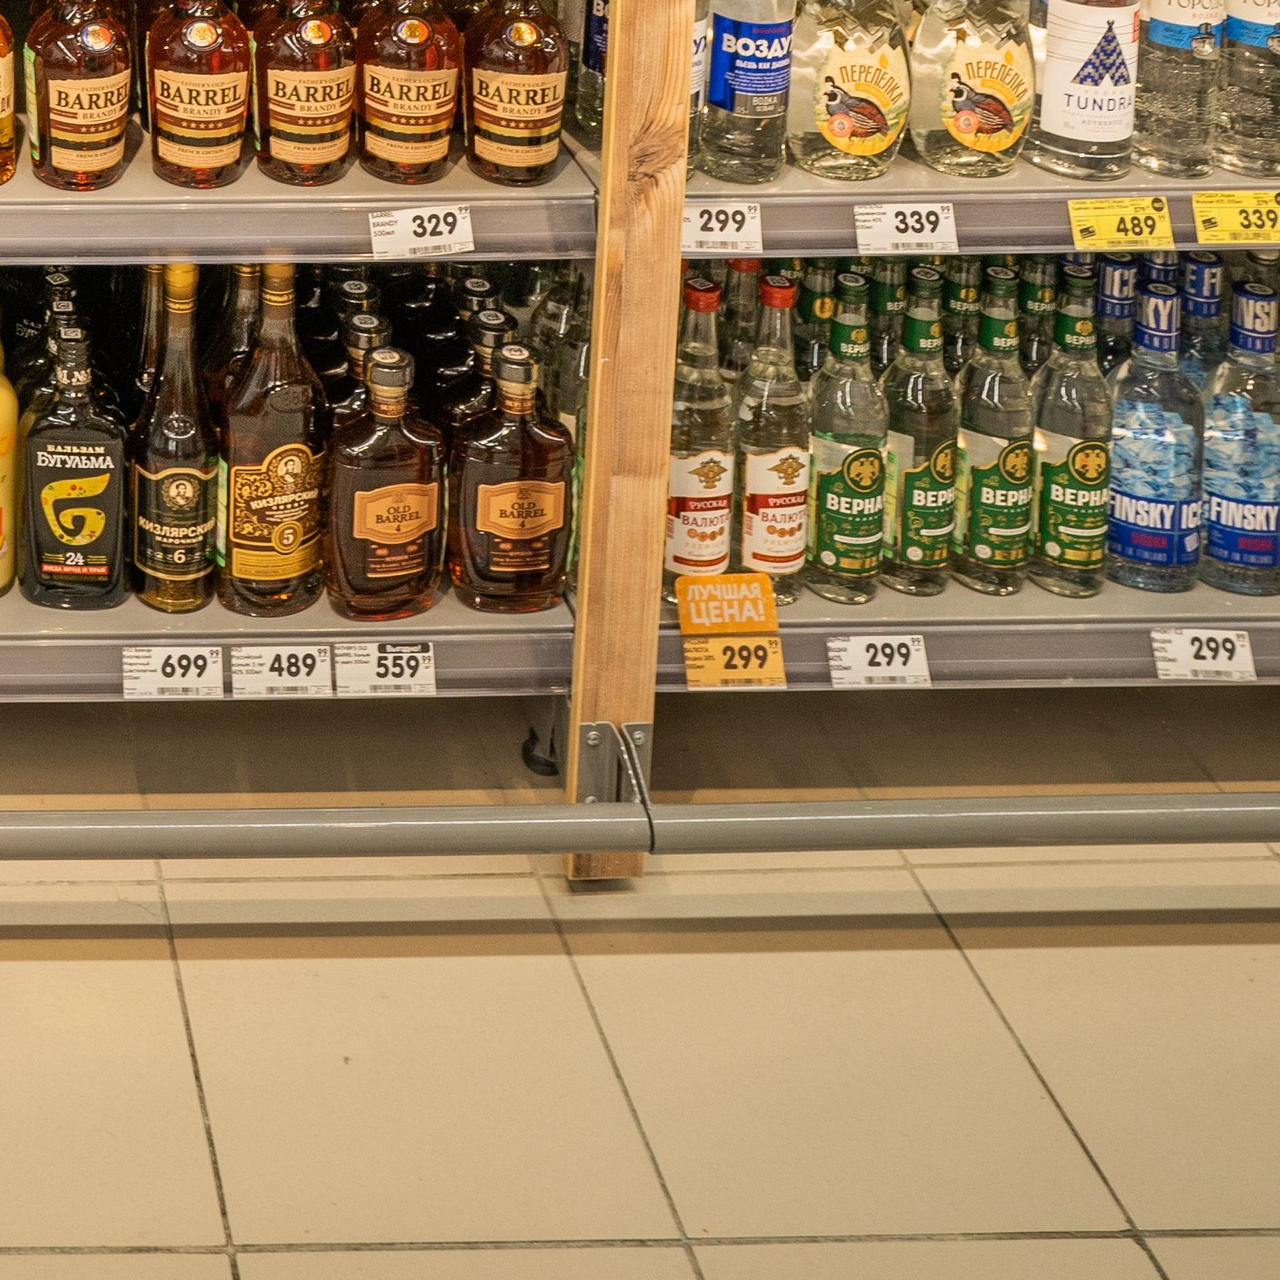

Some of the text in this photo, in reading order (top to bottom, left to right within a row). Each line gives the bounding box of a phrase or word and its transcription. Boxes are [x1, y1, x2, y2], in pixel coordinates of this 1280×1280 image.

[722, 35, 792, 58] ВОЗДУ
[159, 84, 241, 106] BARREL
[369, 82, 451, 102] BARREL
[1064, 93, 1133, 112] TUNDRA
[183, 105, 223, 116] BRANDY
[391, 102, 432, 112] BRANDY
[412, 212, 458, 237] 329
[699, 209, 746, 233] 299
[894, 210, 940, 233] 339
[1116, 215, 1157, 236] 489
[37, 452, 114, 469] БУГУЛЬМА
[375, 511, 421, 524] BARREL
[386, 505, 411, 516] OLD
[1210, 495, 1279, 531] FINSKY
[686, 582, 761, 602] ЛУЧШАЯ
[689, 601, 765, 624] ЦЕНА!
[722, 646, 768, 670] 299
[866, 642, 911, 666] 299
[1190, 637, 1236, 661] 299
[160, 654, 207, 678] 699
[269, 654, 316, 677] 489
[375, 656, 419, 678] 559
